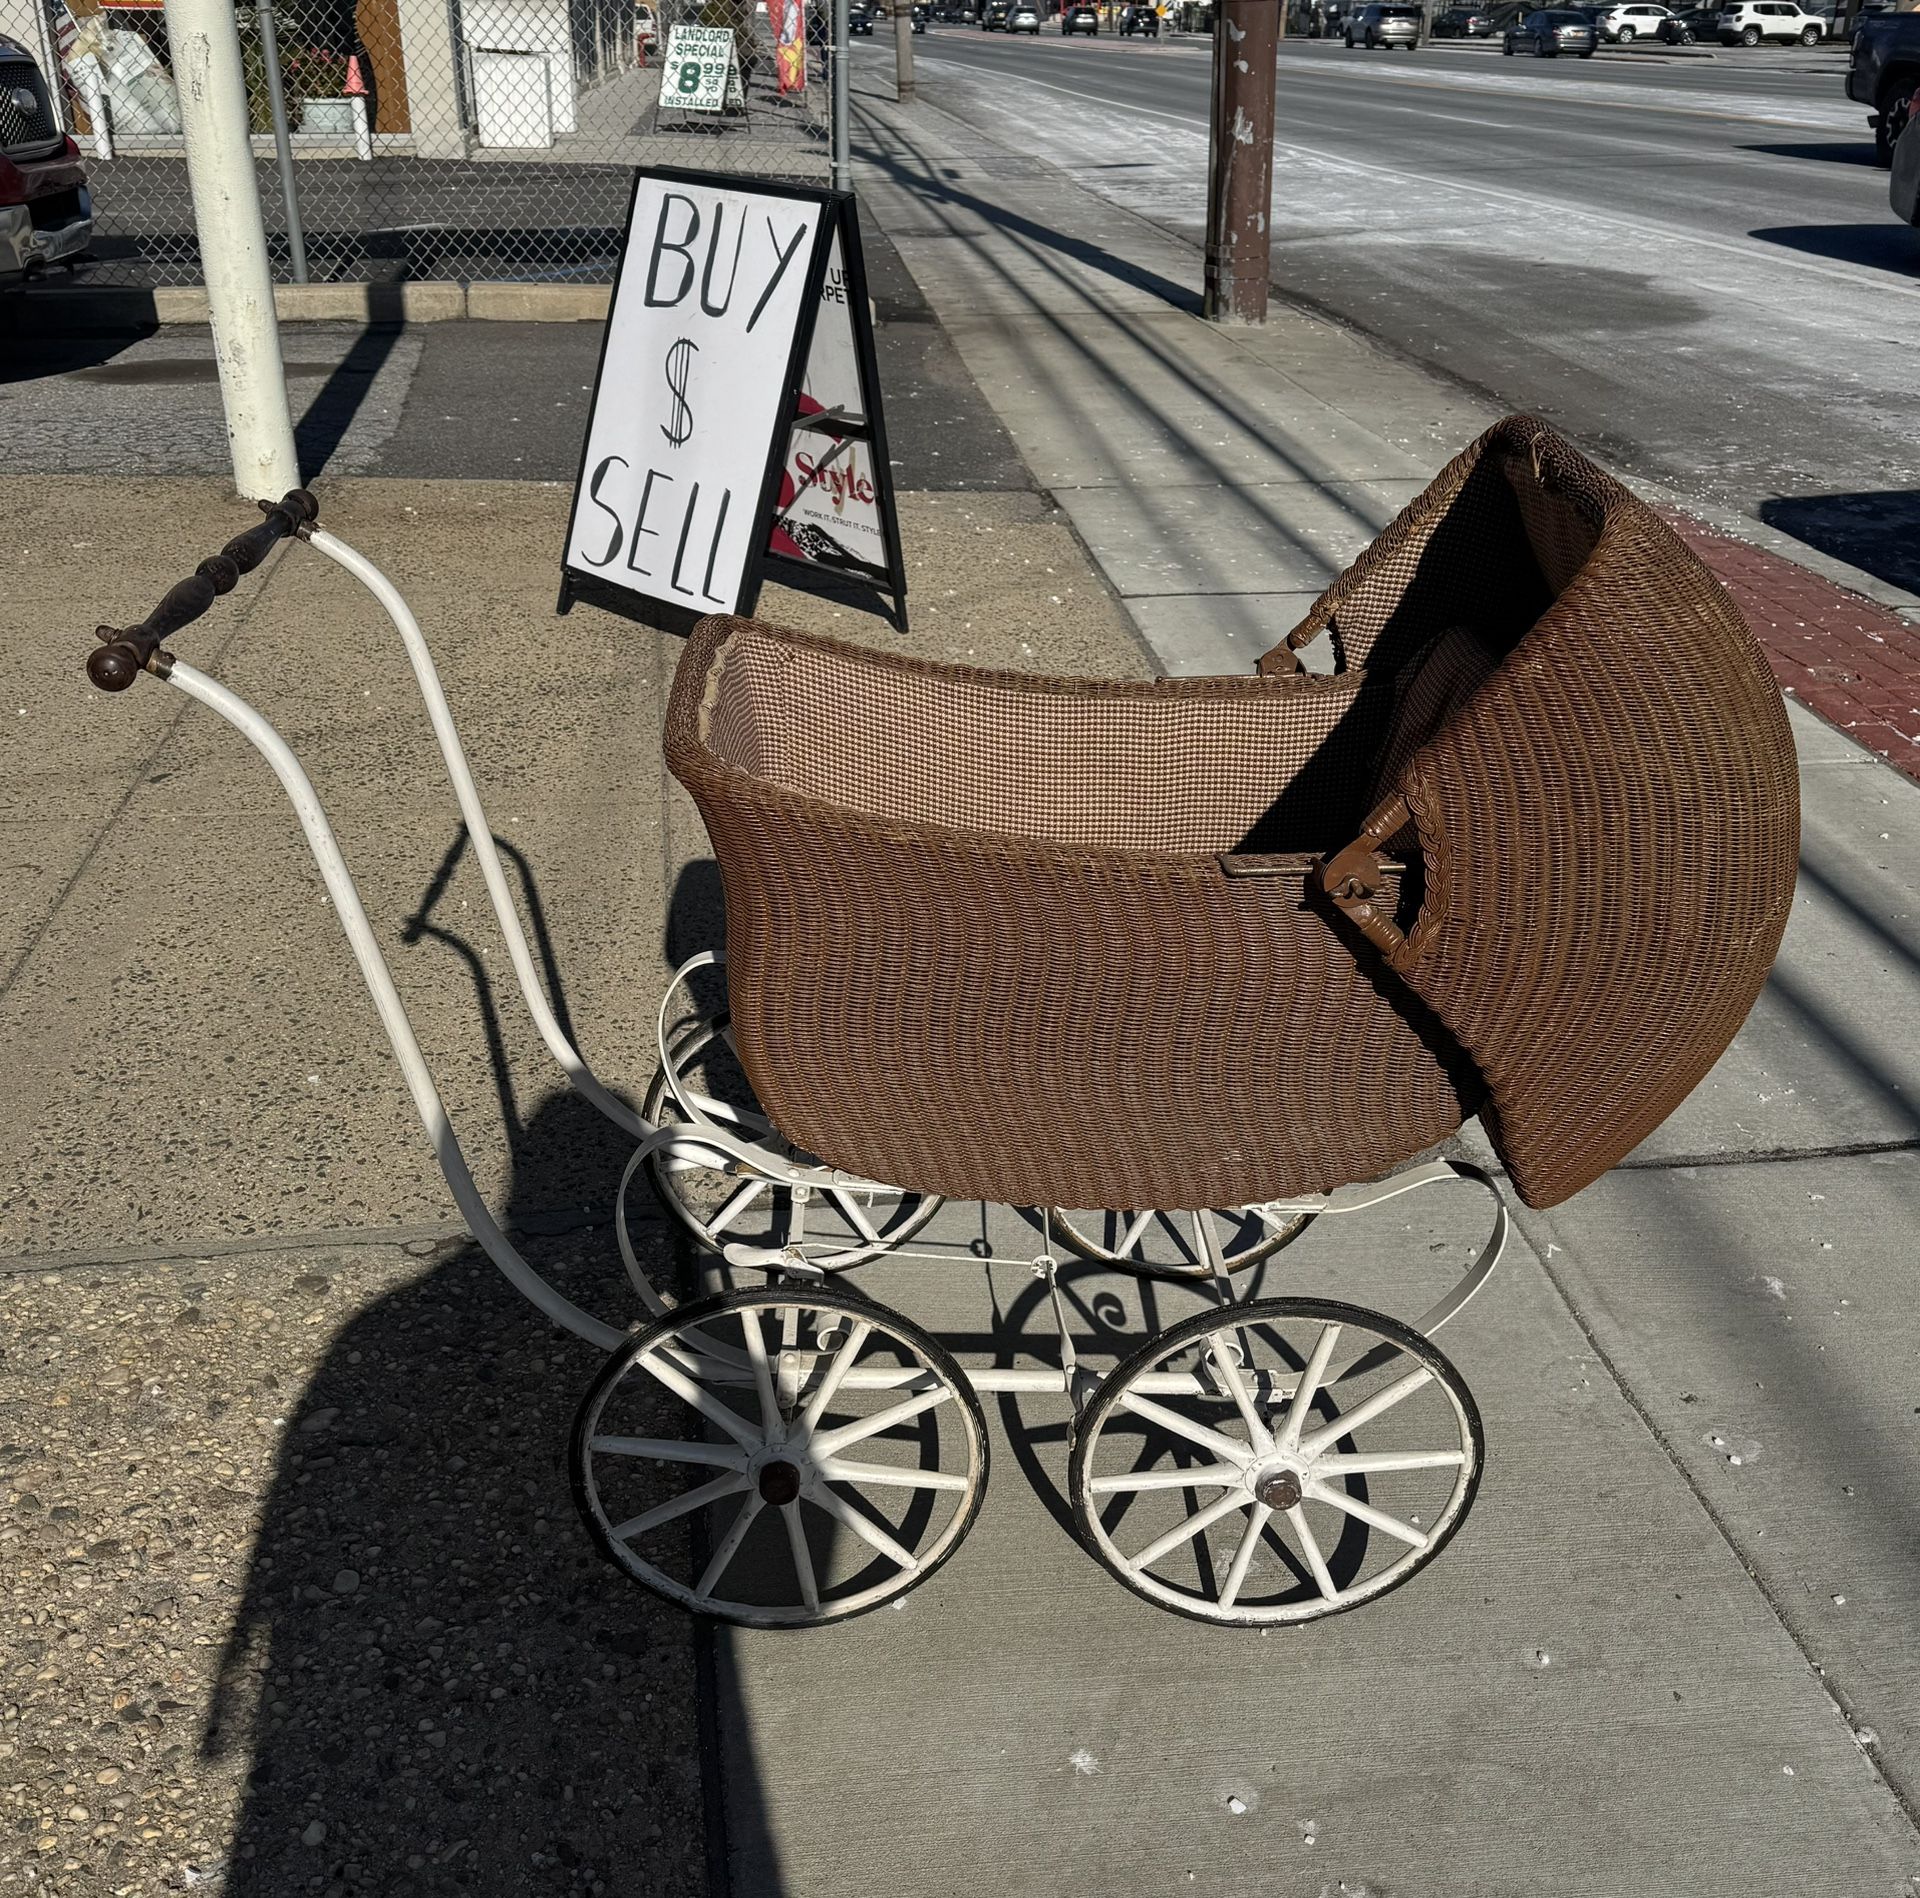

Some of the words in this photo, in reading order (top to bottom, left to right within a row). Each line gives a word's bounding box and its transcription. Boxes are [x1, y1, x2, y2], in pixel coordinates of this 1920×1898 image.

[674, 27, 730, 42] LANDLORD
[675, 43, 724, 57] SPECIAL
[664, 95, 720, 108] INSTALLED
[643, 192, 808, 333] BUY
[660, 336, 700, 449] $
[581, 455, 731, 605] SELL
